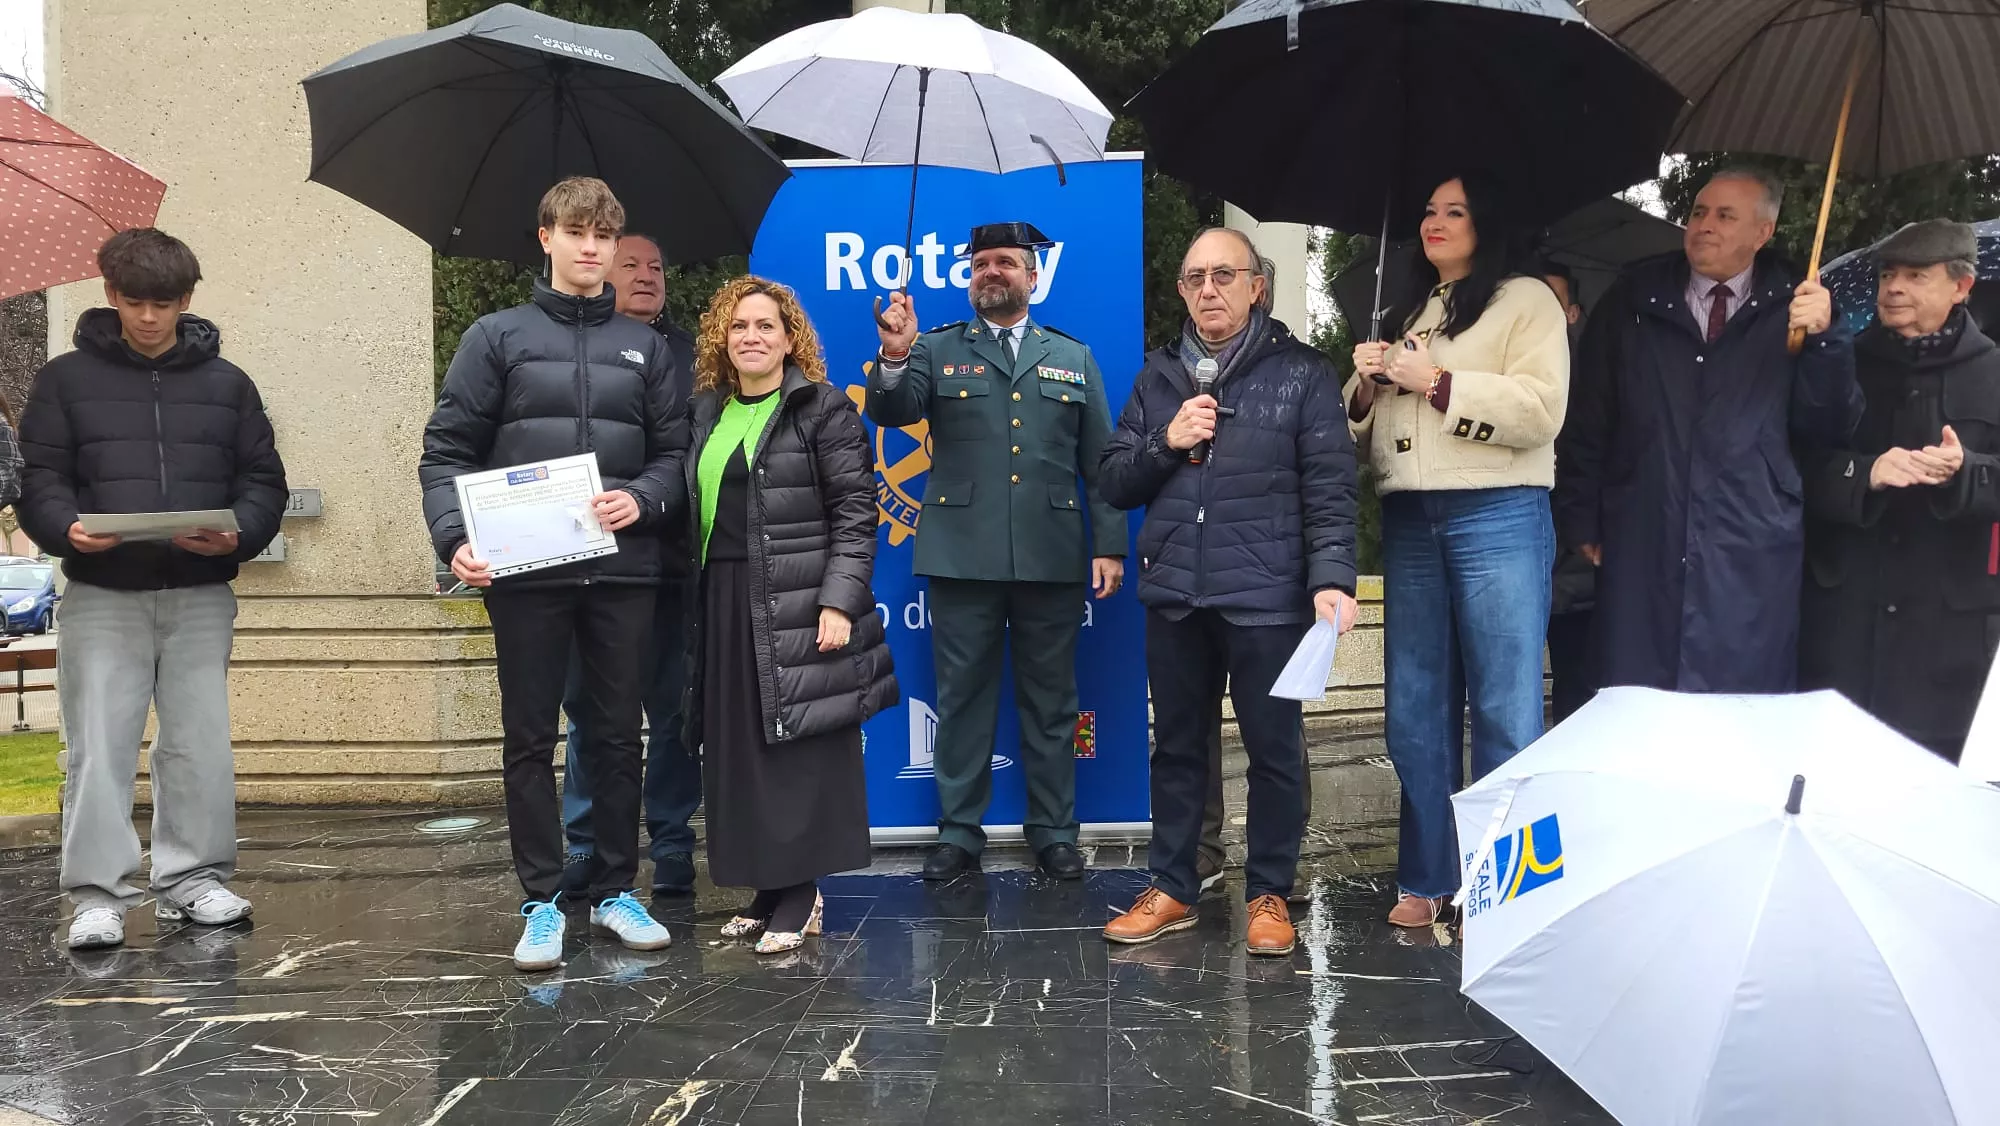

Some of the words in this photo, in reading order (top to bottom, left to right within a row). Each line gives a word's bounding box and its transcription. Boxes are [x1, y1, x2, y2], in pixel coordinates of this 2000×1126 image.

[542, 40, 615, 61] CABRERO
[825, 231, 1064, 305] Rotay
[876, 481, 920, 528] INTE
[904, 590, 933, 630] d
[1476, 849, 1491, 914] EALE
